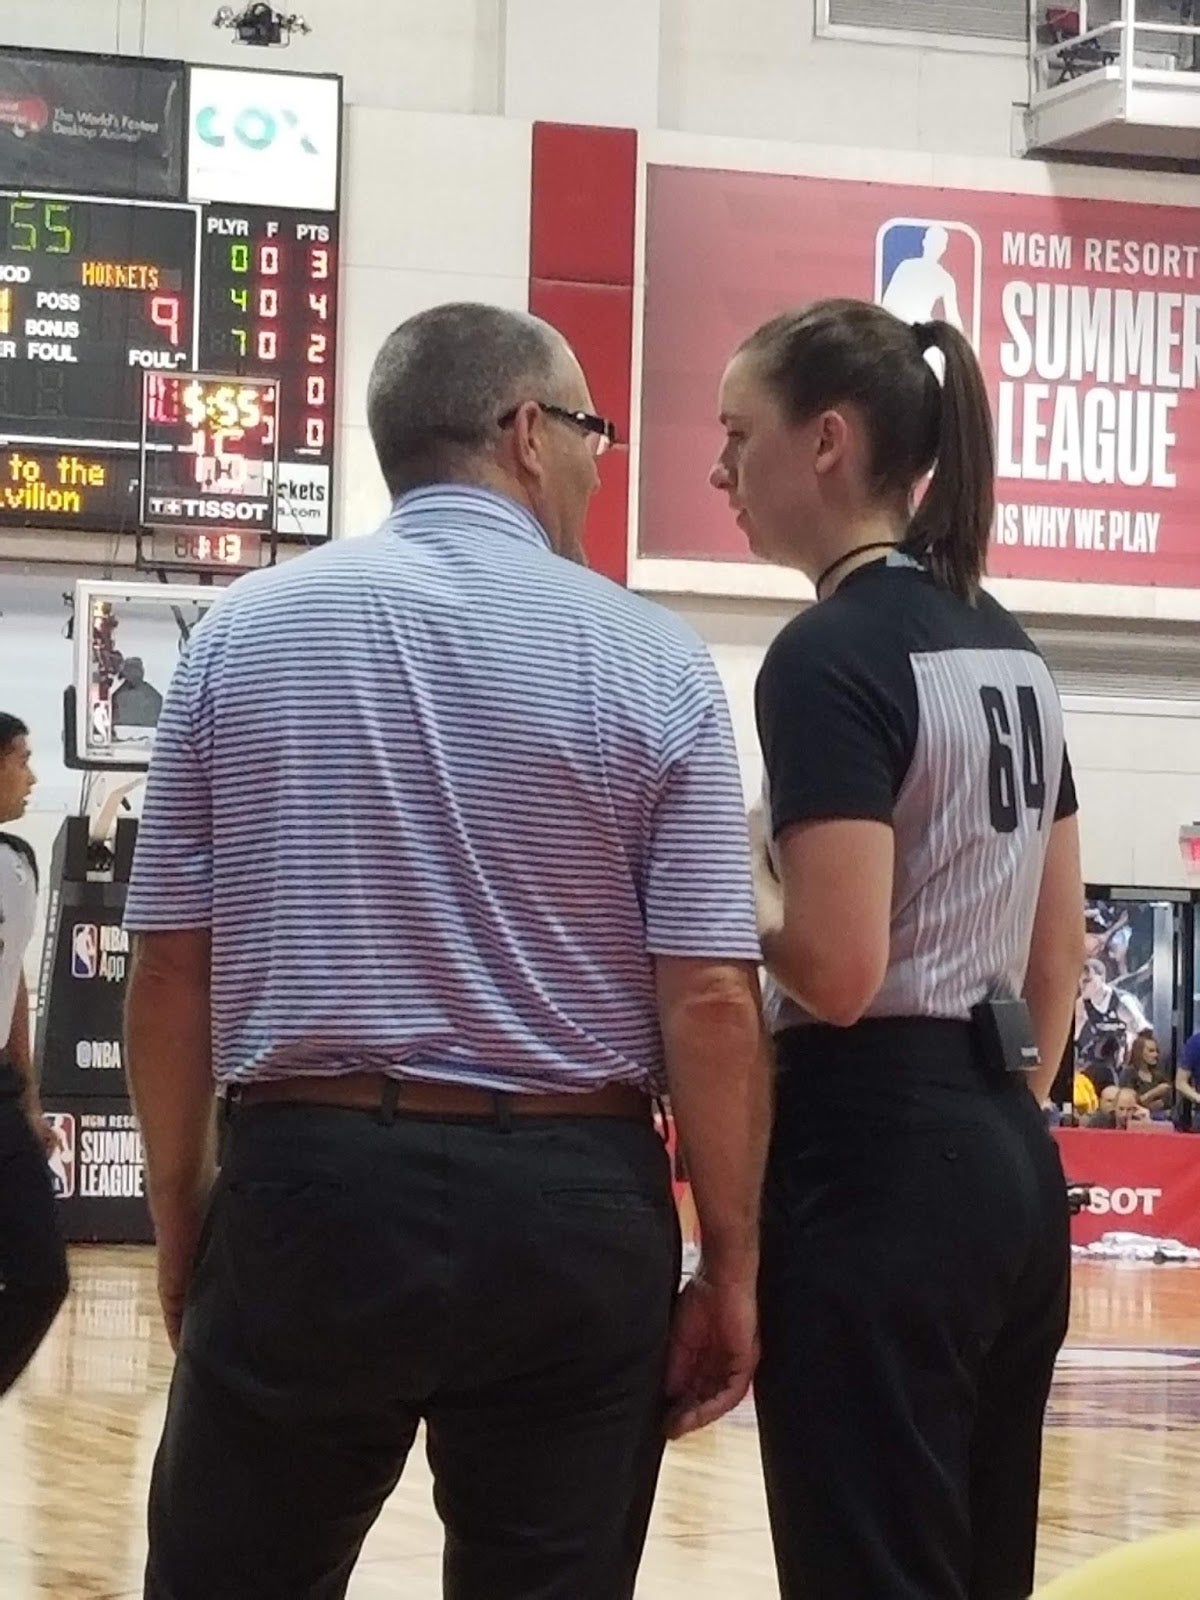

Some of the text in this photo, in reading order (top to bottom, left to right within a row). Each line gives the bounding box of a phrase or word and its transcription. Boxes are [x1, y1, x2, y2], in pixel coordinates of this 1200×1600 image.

[207, 217, 330, 242] PLYR F PTS
[231, 245, 328, 278] 0 0 3
[1002, 231, 1072, 270] MGM
[36, 291, 81, 311] POSS
[230, 289, 327, 319] 4 0 4
[25, 319, 80, 338] BONUS
[151, 296, 179, 346] 9
[28, 342, 78, 362] FOUL
[231, 329, 326, 363] 7 0 2
[307, 376, 325, 405] 0
[307, 418, 325, 446] 0
[997, 381, 1178, 488] LEAGUE
[9, 453, 105, 486] to the
[186, 500, 268, 520] TISSOT
[997, 503, 1161, 553] IS WHY WE PLAY
[980, 685, 1045, 833] 64
[100, 925, 129, 953] NBA
[99, 954, 125, 982] App
[76, 1040, 121, 1069] @NBA
[80, 1164, 144, 1197] LEAGUE
